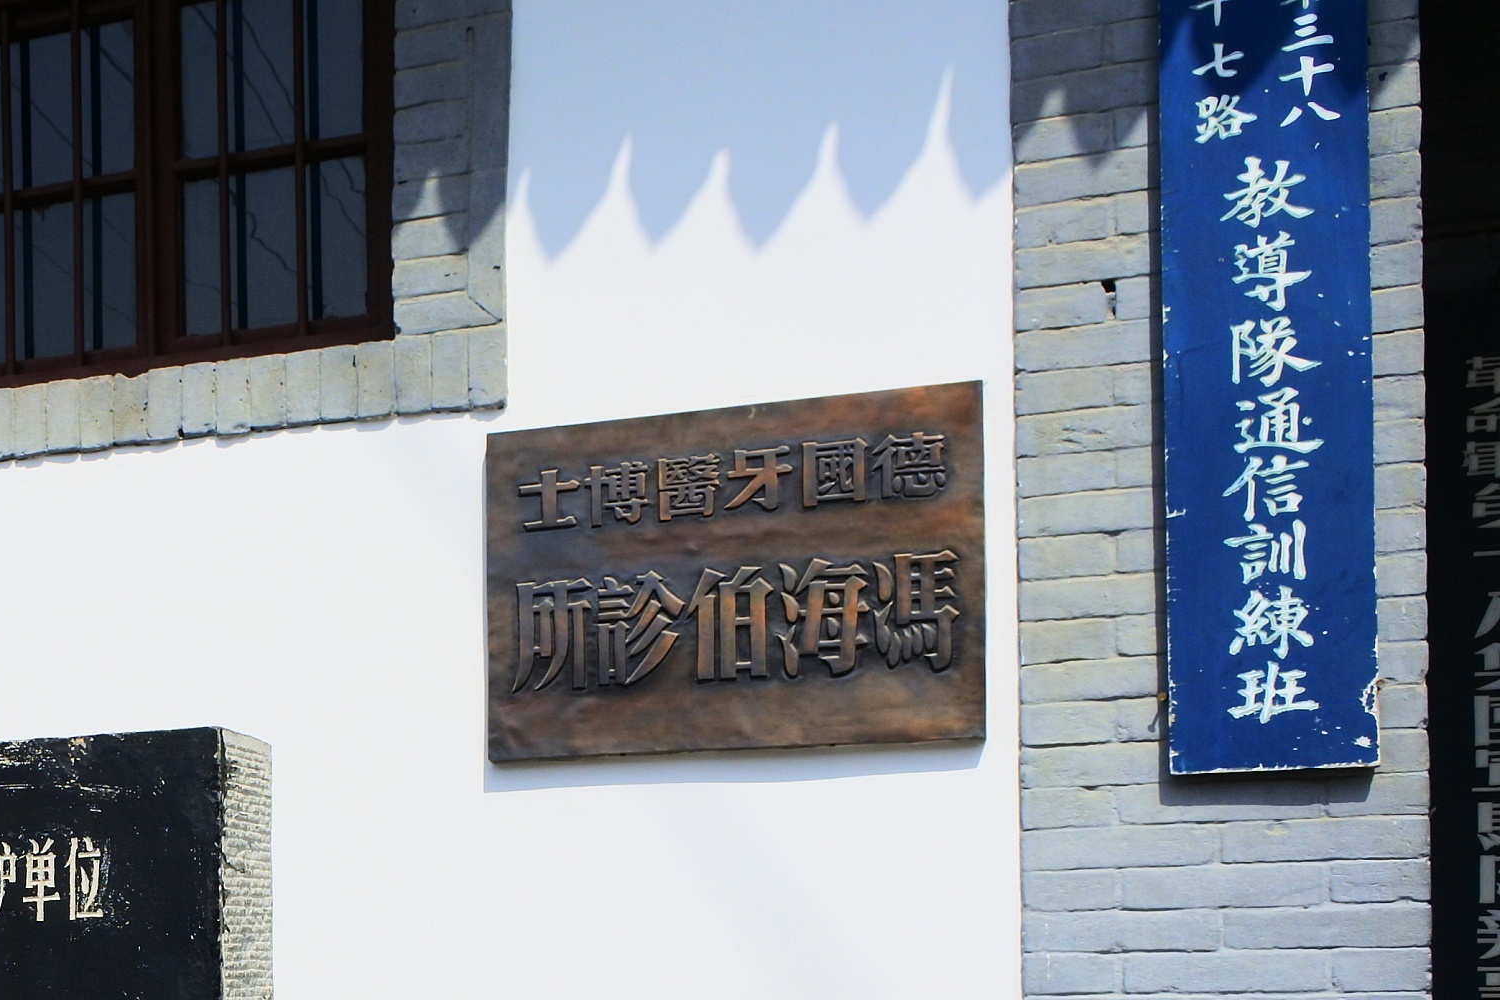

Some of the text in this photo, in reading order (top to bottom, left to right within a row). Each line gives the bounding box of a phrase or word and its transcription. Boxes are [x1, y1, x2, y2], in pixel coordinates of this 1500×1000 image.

[1279, 0, 1341, 127] 三十八
[1220, 156, 1325, 723] 教導隊通信訓練班
